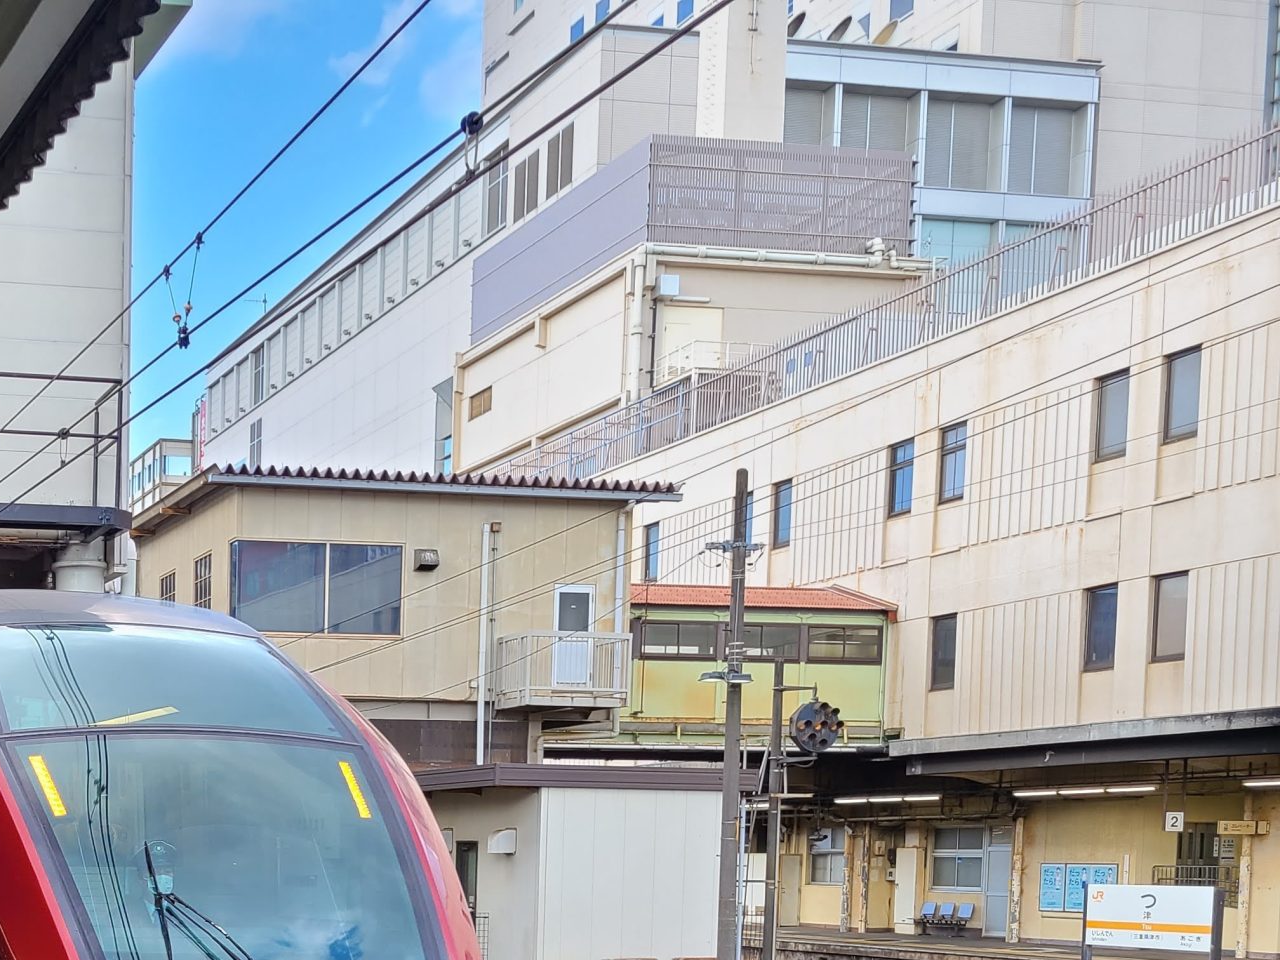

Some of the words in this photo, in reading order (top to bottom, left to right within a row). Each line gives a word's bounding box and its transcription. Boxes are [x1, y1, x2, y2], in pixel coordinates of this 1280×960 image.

[1170, 816, 1179, 827] 2
[1092, 891, 1104, 900] JR
[1140, 893, 1157, 909] つ
[1143, 911, 1152, 920] 津
